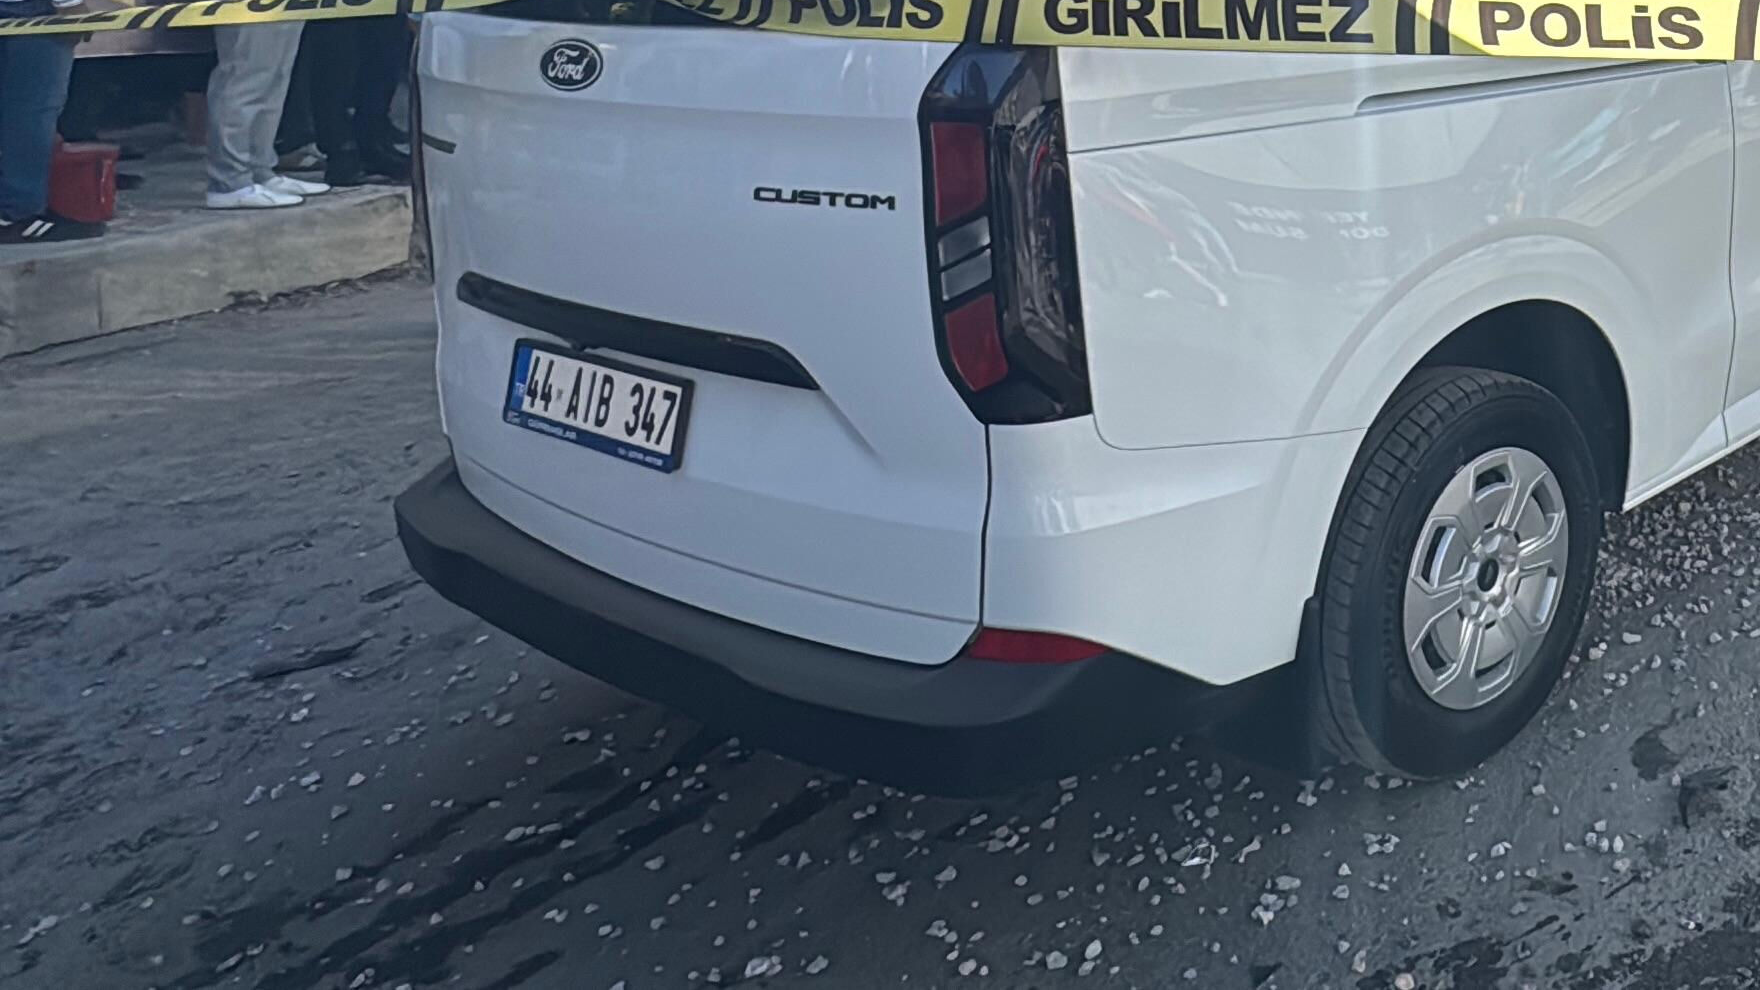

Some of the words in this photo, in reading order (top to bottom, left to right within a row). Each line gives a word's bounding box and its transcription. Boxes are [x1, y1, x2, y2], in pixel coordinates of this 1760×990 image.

[547, 47, 591, 82] Ford
[753, 186, 896, 211] CUSTOM
[526, 355, 555, 412] 44
[564, 366, 615, 428] AIB
[624, 382, 678, 446] 347
